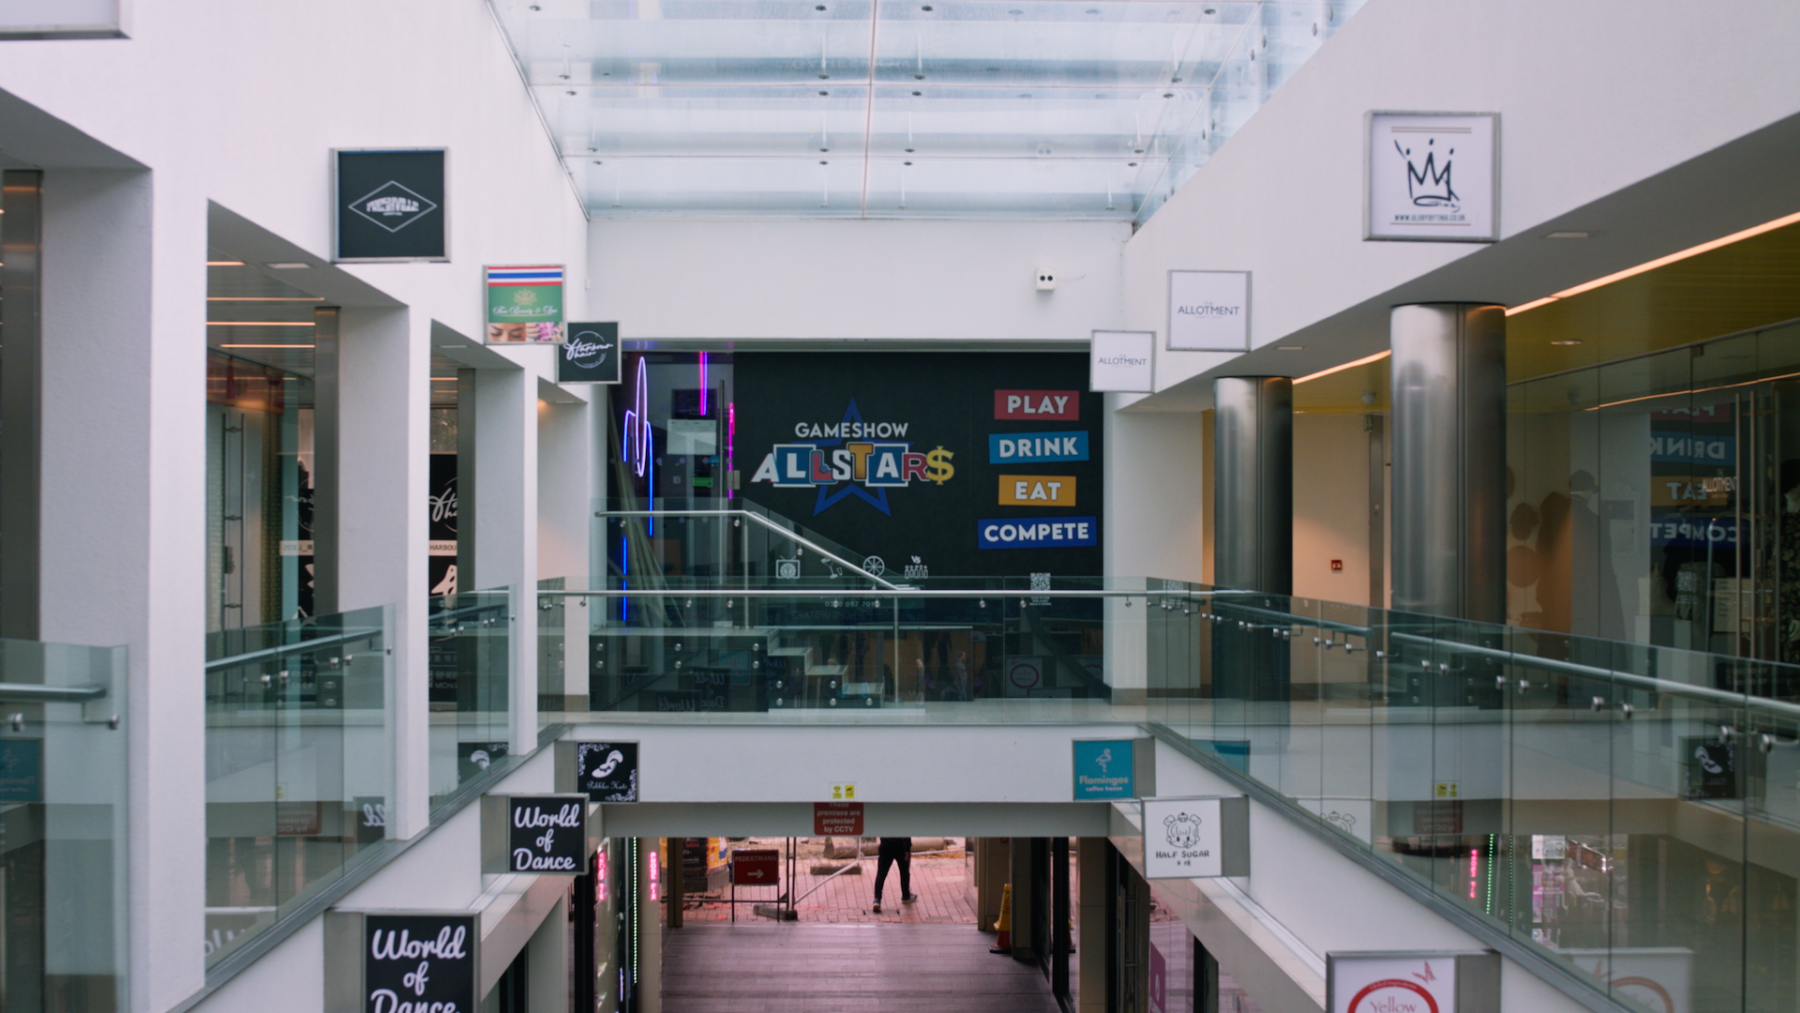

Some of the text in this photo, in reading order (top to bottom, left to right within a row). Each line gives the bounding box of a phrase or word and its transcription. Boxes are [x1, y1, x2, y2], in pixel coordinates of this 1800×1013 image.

[1177, 305, 1240, 315] ALLOTMENT
[1098, 357, 1147, 366] ALLOTMENT
[1007, 395, 1069, 414] PLAY
[794, 422, 909, 438] GAMESHOW
[999, 437, 1079, 458] DRINK
[750, 442, 956, 486] ALLSTAR$
[1015, 481, 1062, 501] EAT
[984, 522, 1089, 542] COMPETE
[1079, 774, 1129, 786] Flamingos
[513, 803, 580, 828] World
[535, 828, 555, 853] of
[513, 847, 576, 871] Dance
[1155, 850, 1210, 859] HALF SUGAR
[371, 925, 467, 960] World
[403, 960, 430, 997] of
[1369, 996, 1418, 1013] Yellow
